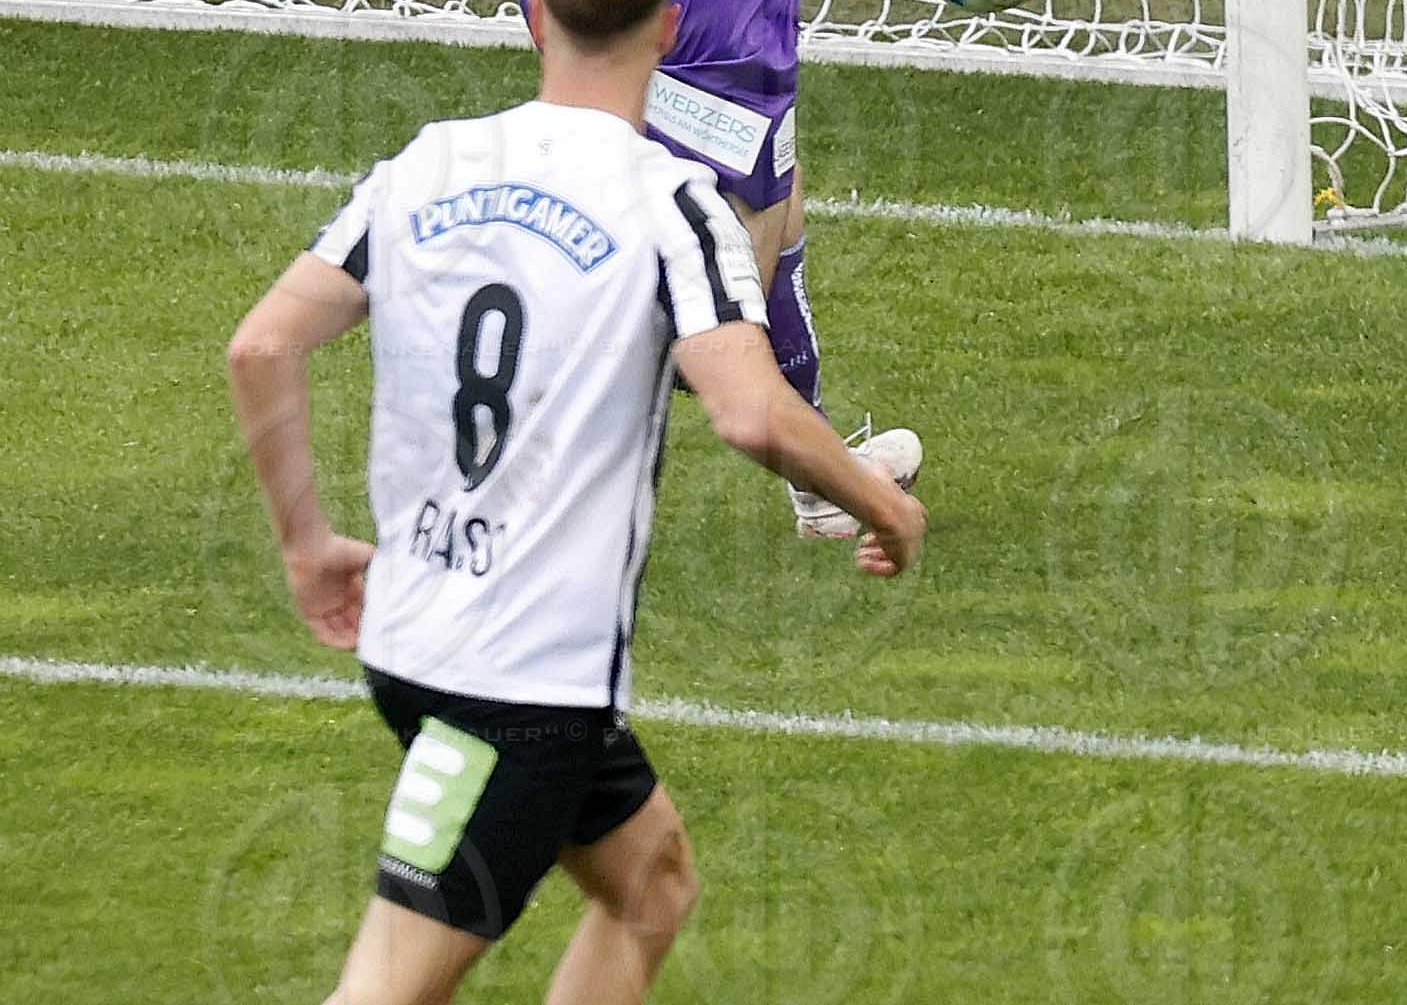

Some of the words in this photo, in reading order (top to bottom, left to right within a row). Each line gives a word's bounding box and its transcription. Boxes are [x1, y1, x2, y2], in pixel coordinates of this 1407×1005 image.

[653, 81, 758, 143] WERZERS
[417, 185, 611, 267] PUNTIGAMER
[453, 283, 527, 492] 8
